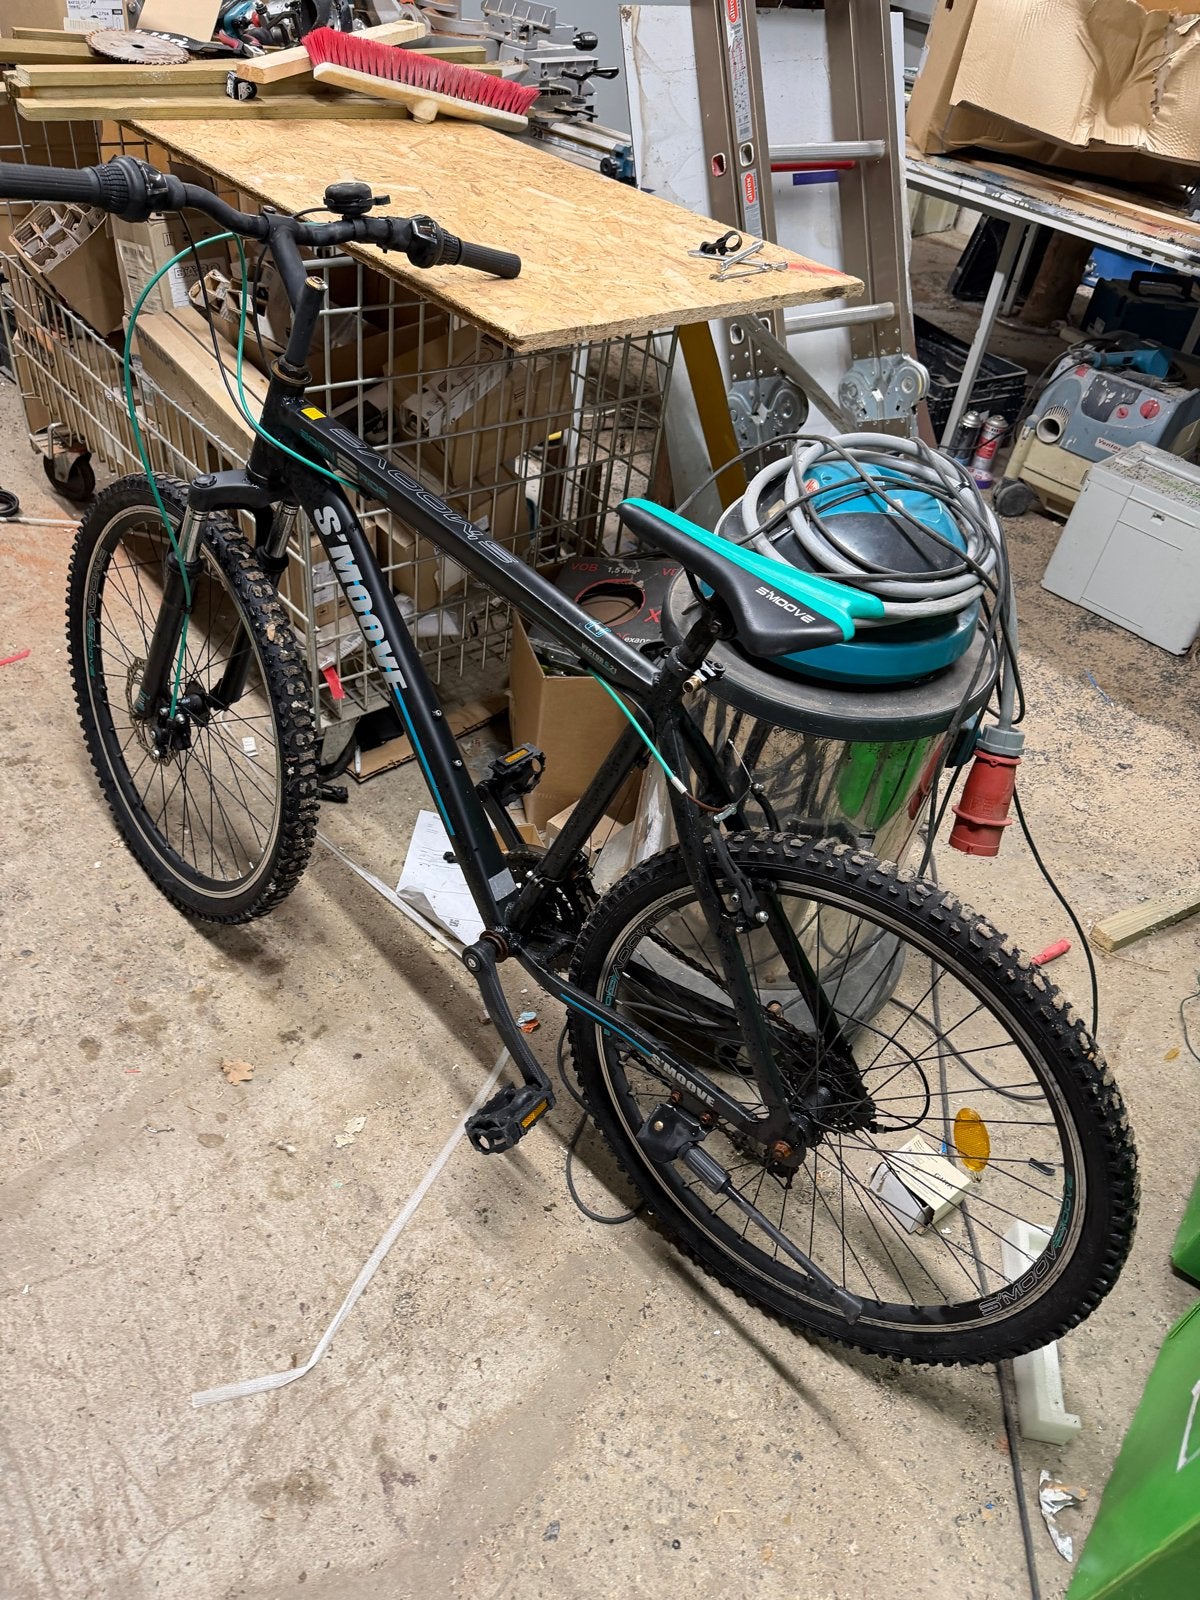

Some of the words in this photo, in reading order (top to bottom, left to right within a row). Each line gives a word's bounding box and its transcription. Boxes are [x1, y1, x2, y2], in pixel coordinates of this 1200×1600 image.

[570, 563, 599, 572] VOB
[313, 505, 408, 692] S'MOOVE
[755, 586, 816, 624] S'MOOVE
[651, 1053, 716, 1109] S'MOOVE
